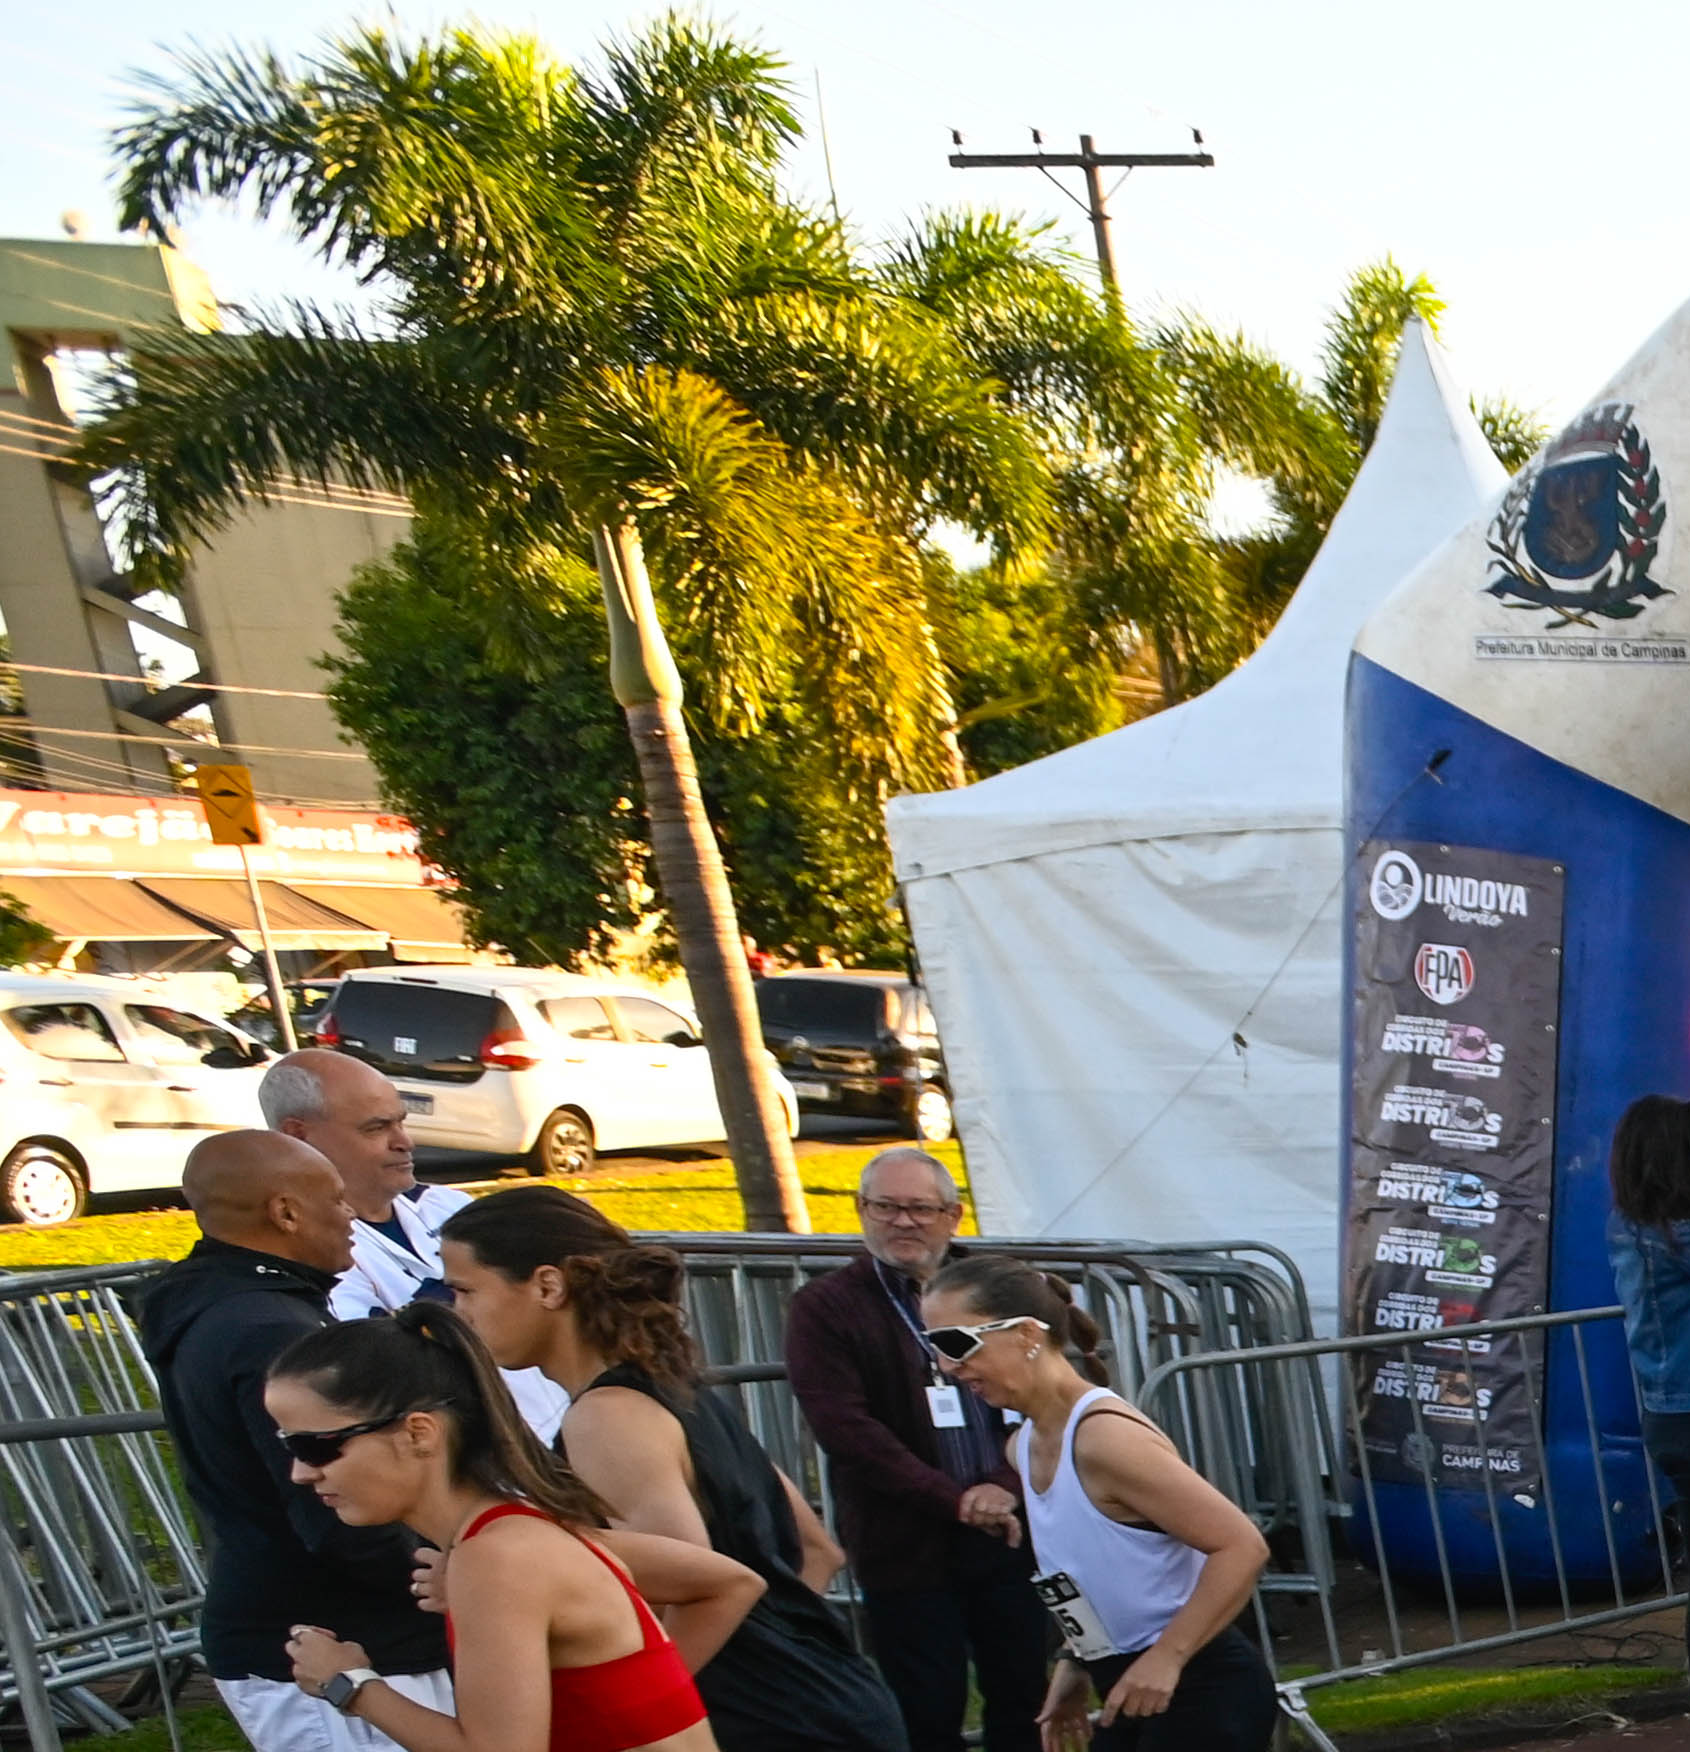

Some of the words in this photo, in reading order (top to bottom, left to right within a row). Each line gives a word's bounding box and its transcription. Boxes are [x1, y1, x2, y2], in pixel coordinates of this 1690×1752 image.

[1476, 641, 1535, 656] Prefeitura
[1537, 642, 1598, 659] Municipal
[1602, 643, 1617, 657] de
[1620, 643, 1687, 661] Campinas
[1425, 873, 1528, 916] LINDOYA
[1444, 904, 1503, 927] Verão
[1425, 948, 1464, 994] FPA
[1443, 1454, 1521, 1472] CAMPNAS
